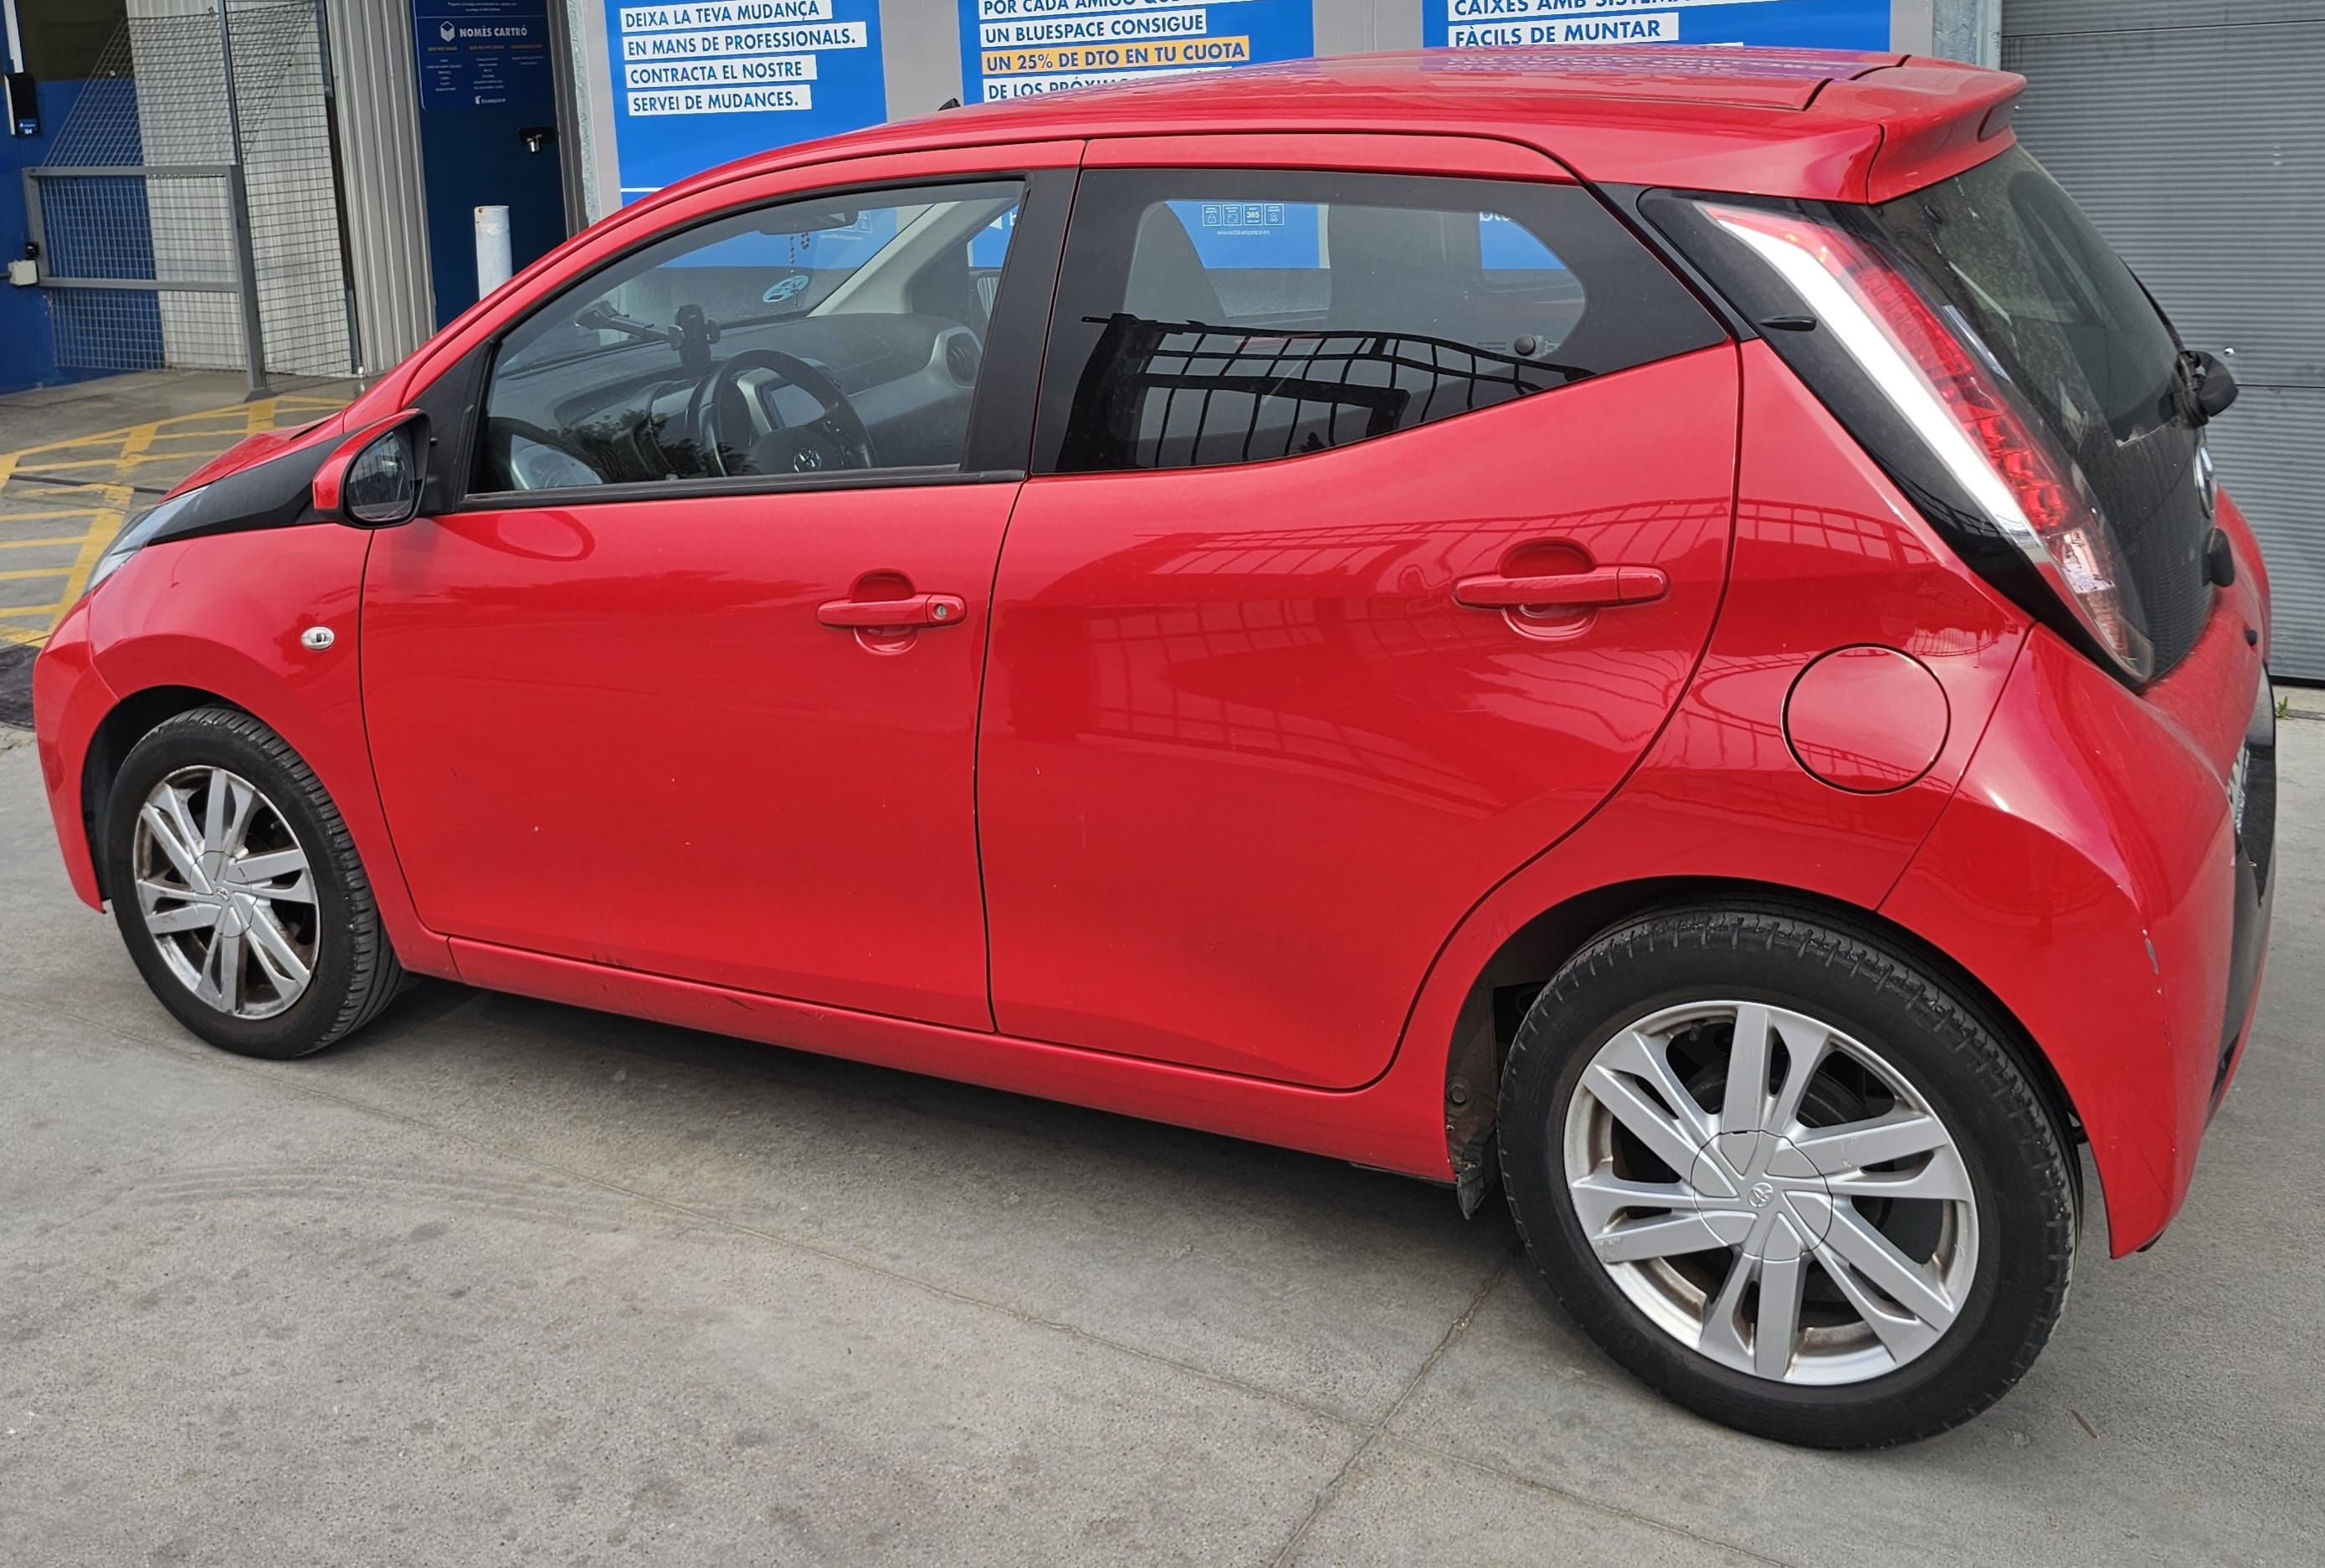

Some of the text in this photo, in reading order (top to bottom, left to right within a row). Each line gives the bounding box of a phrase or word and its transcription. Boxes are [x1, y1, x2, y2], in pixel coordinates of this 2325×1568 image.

[625, 1, 820, 28] DEIXA LA TEVA MUDANÇA
[984, 0, 1017, 15] POR
[1023, 0, 1069, 12] CADA
[1455, 0, 1529, 15] CAIXES
[459, 24, 527, 38] NOMÉS CARTRÓ
[986, 15, 1203, 43] UN BLUESPACE CONSIGUE
[1455, 20, 1660, 47] FÀCILS DE MUNTAR
[629, 28, 855, 56] EN MANS DE PROFESSIONALS.
[988, 43, 1245, 71] UN 25% DE DTO EN TU CUOTA
[630, 61, 802, 84] CONTRACTA EL NOSTRE
[634, 91, 798, 111] SERVEI DE MUDANCES.
[988, 85, 1007, 99] DE
[1014, 83, 1043, 97] LOS
